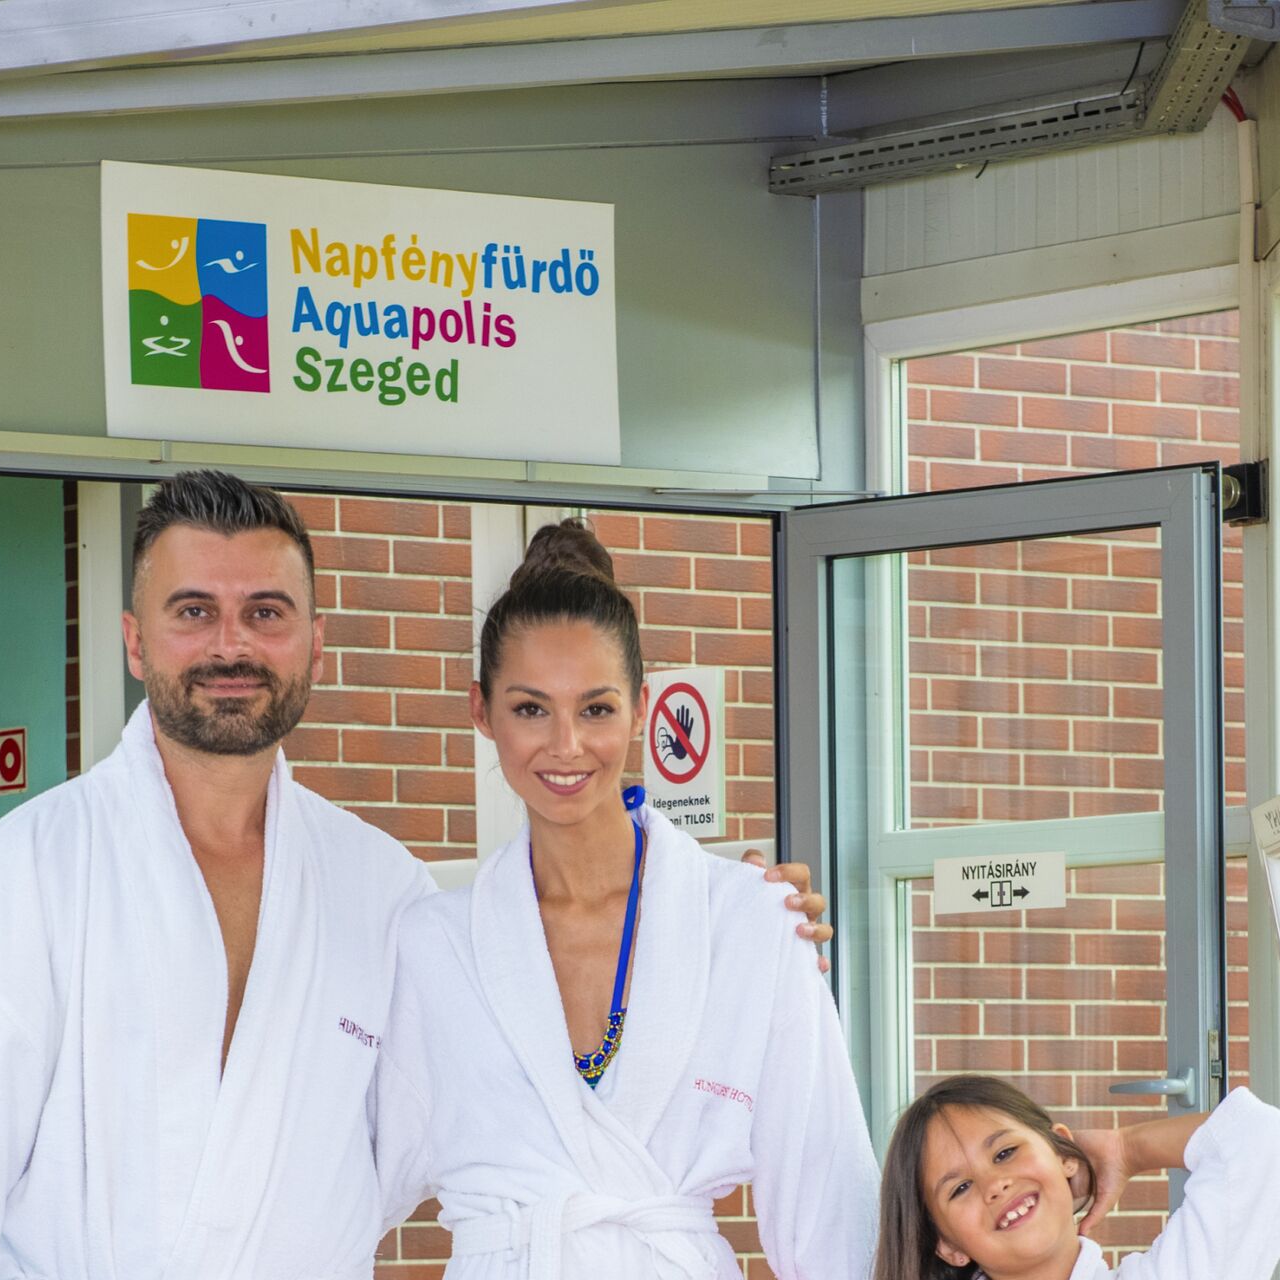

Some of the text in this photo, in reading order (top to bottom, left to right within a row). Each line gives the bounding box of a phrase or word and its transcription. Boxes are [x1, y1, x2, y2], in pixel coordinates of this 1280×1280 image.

[292, 286, 517, 350] Aquapolis
[293, 346, 460, 406] Szeged
[653, 795, 710, 810] Idegeneknek
[685, 813, 715, 826] TILOS!
[961, 859, 1037, 880] NYITÁSIRÁNY
